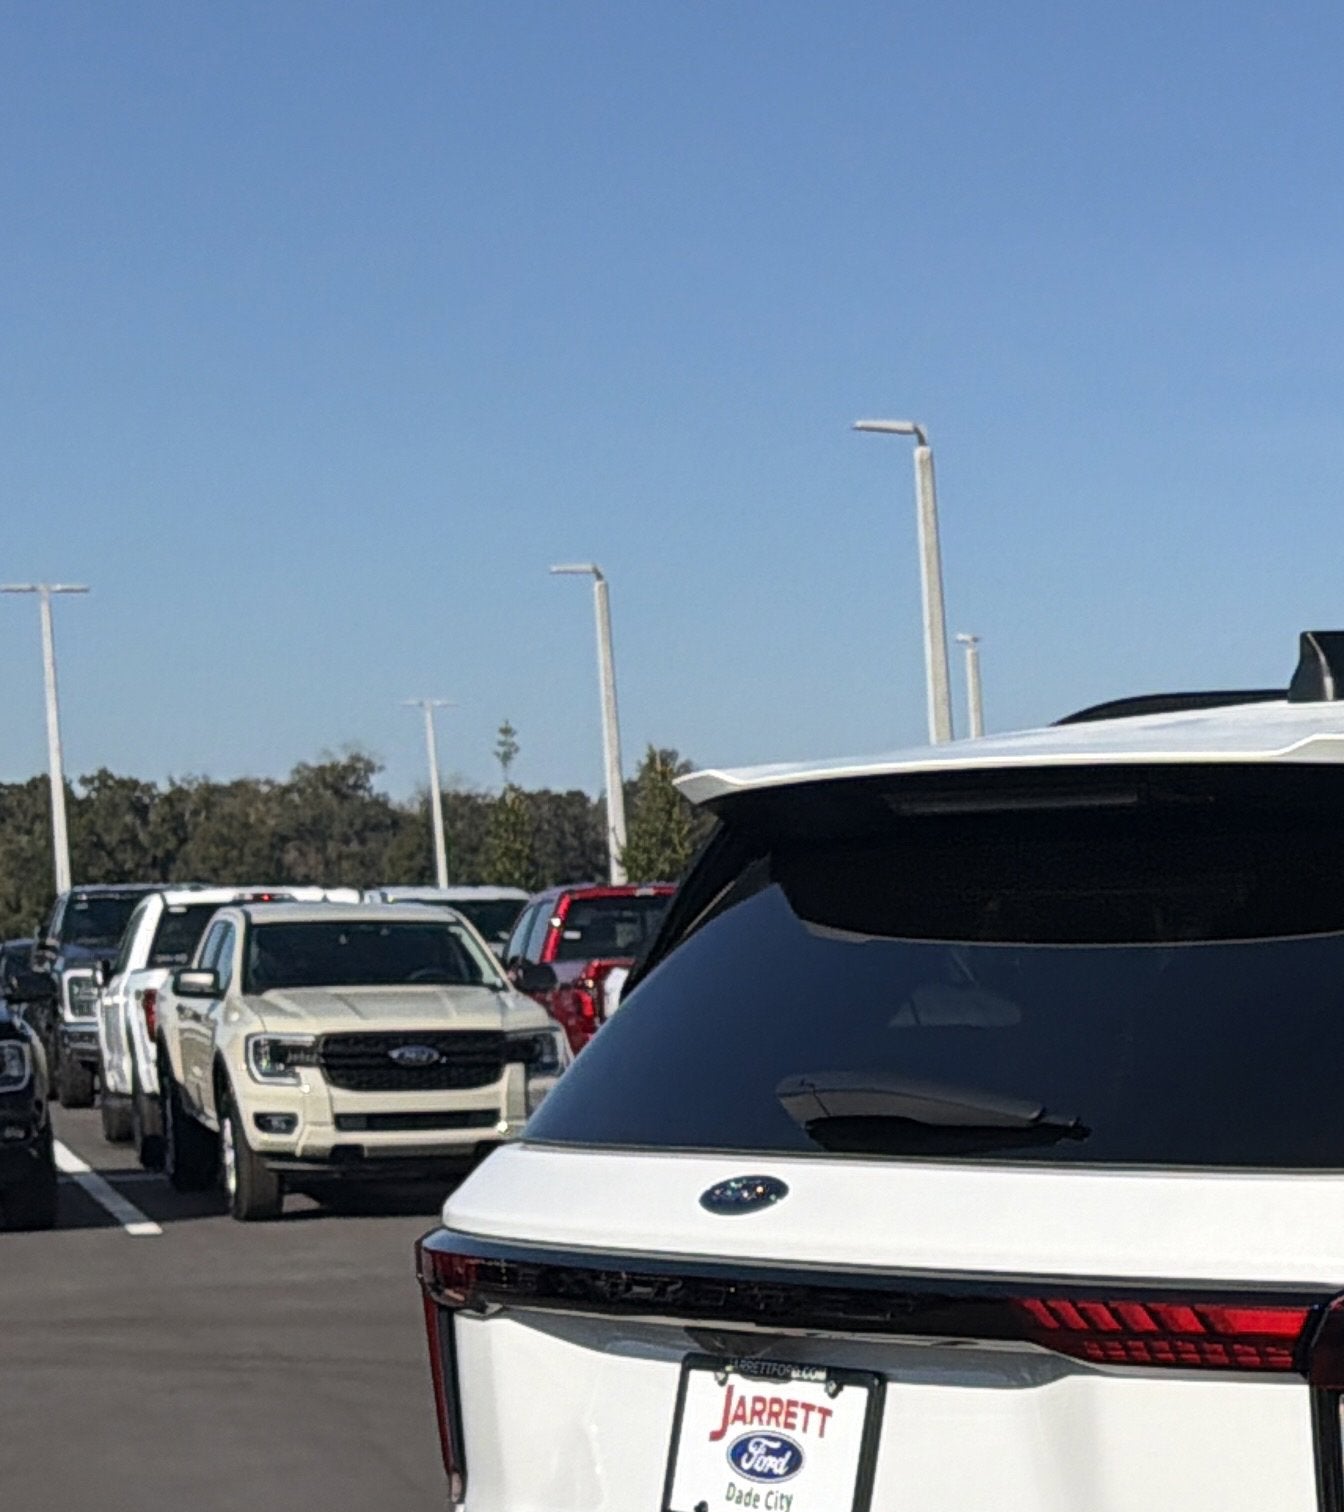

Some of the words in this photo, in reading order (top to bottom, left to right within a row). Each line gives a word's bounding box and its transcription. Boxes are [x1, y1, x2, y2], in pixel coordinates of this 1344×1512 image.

[709, 1384, 832, 1441] JARRETT
[741, 1437, 792, 1475] Ford
[725, 1481, 761, 1509] Dade
